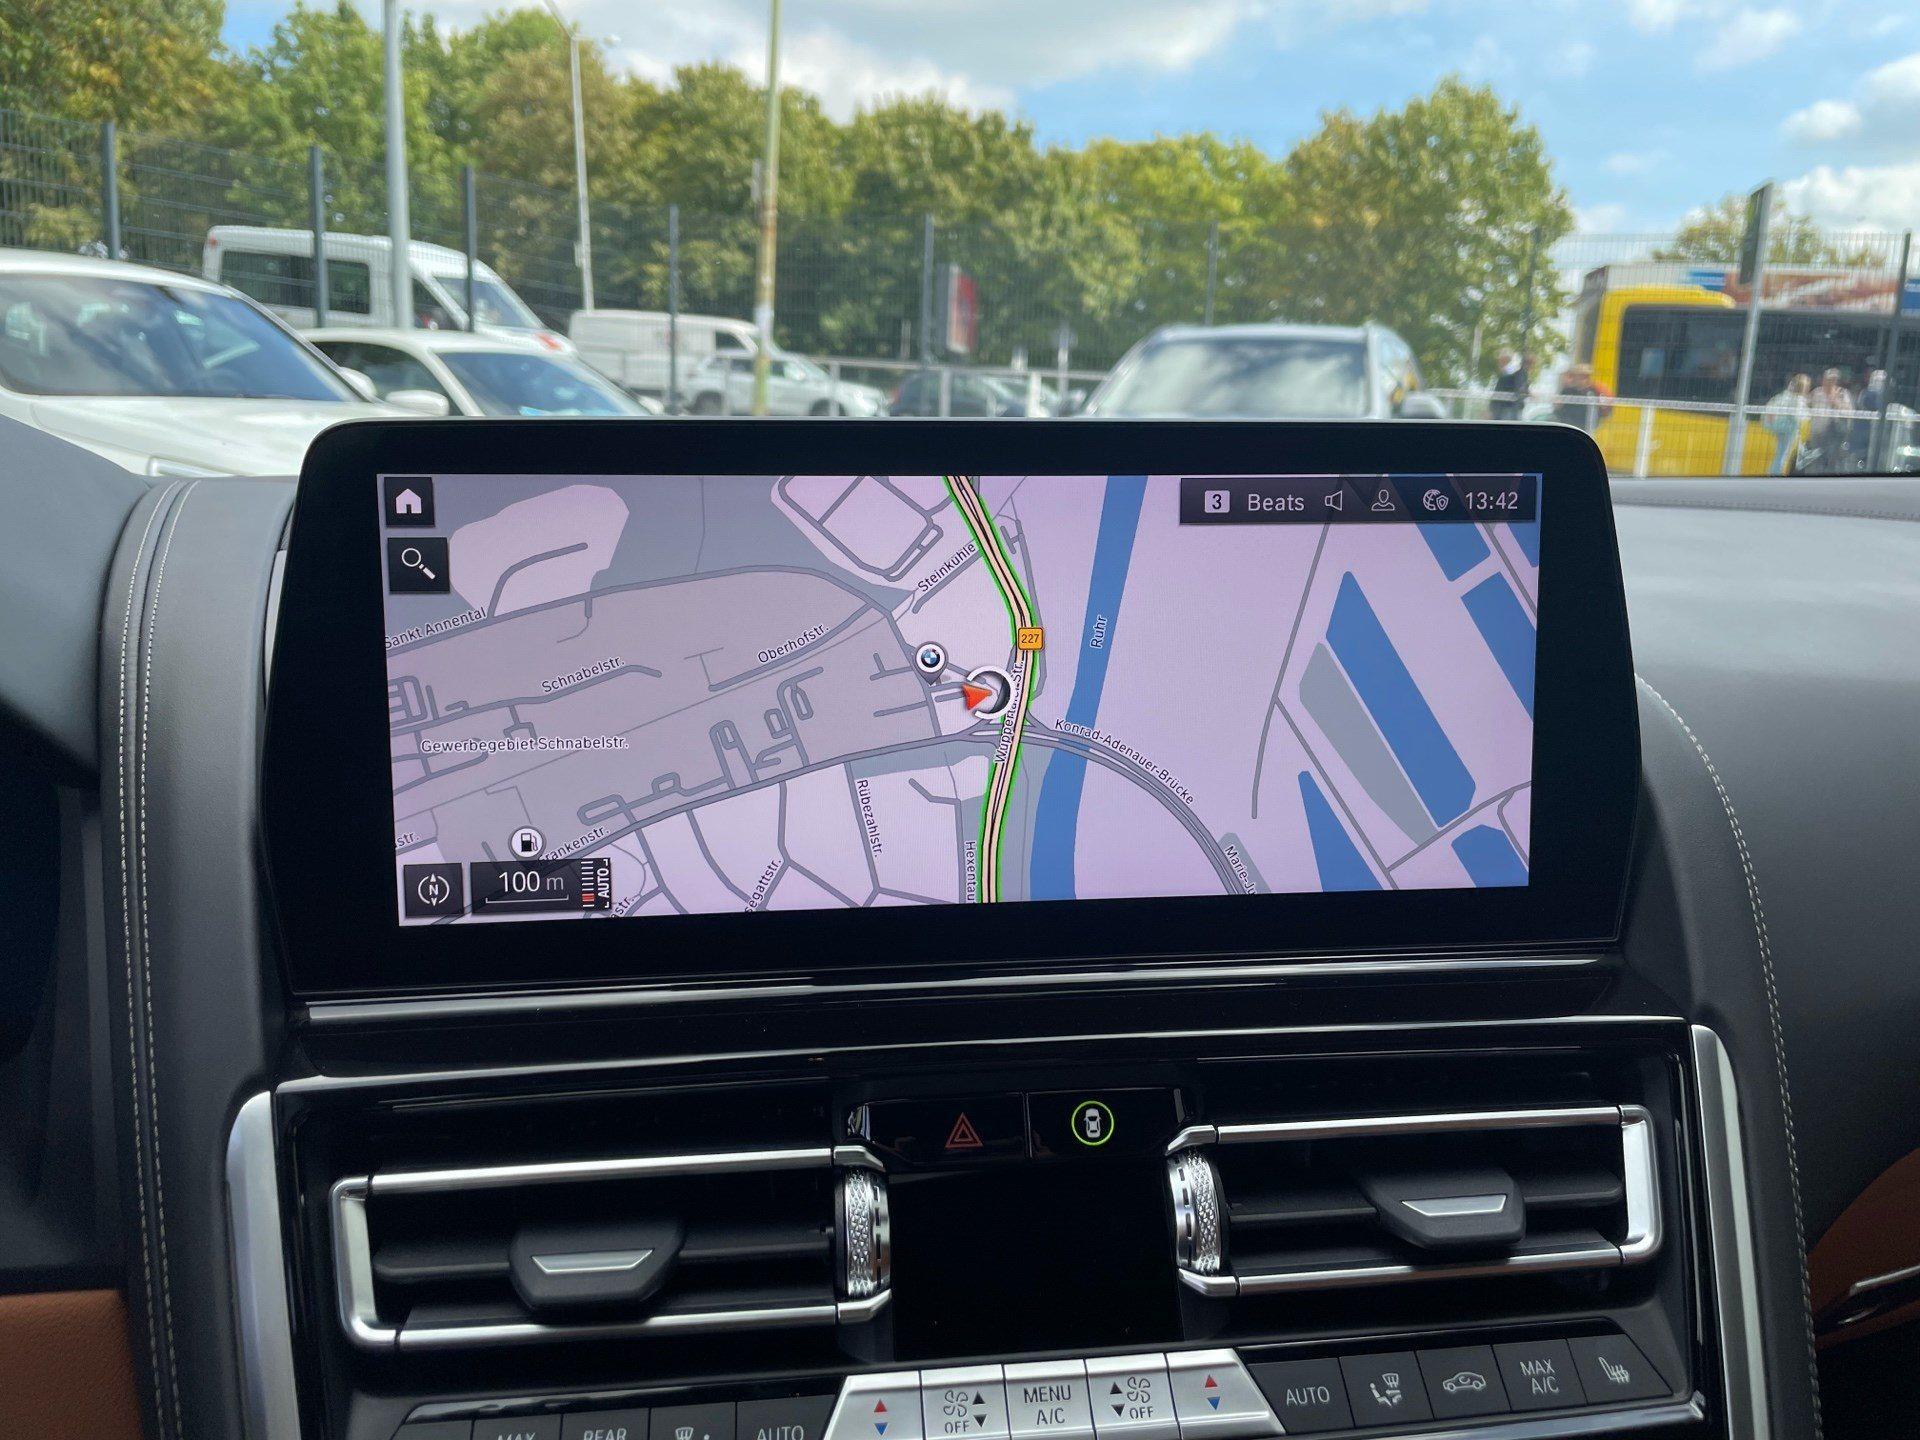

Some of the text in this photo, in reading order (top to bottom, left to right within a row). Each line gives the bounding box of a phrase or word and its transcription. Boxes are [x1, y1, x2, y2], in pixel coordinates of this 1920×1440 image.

[1212, 494, 1222, 508] 3
[1248, 493, 1305, 511] Beats
[1465, 491, 1518, 510] 13:42
[426, 607, 487, 636] Annental
[1021, 633, 1040, 644] 227
[1091, 616, 1107, 648] Ruhr
[758, 622, 830, 663] Oberhofstr.
[541, 656, 625, 693] Schnabelstr.
[421, 737, 629, 753] Gewerbegebiet Schnabelstr.
[1055, 719, 1194, 805] Konrad-Adenauer-Brücke
[857, 780, 882, 858] Rübezahlstr.
[541, 827, 610, 860] rankenstr.
[499, 871, 564, 892] 100 m
[965, 842, 976, 903] Hexentau
[429, 884, 439, 895] N
[597, 868, 610, 898] AUTO
[1520, 1359, 1555, 1377] MAX
[1023, 1384, 1072, 1404] MENU
[1531, 1376, 1560, 1395] A/C
[1285, 1386, 1330, 1406] AUTO
[1036, 1408, 1066, 1426] A/C
[1129, 1406, 1154, 1420] OFF
[756, 1425, 805, 1440] AUTO
[944, 1420, 970, 1434] OFF
